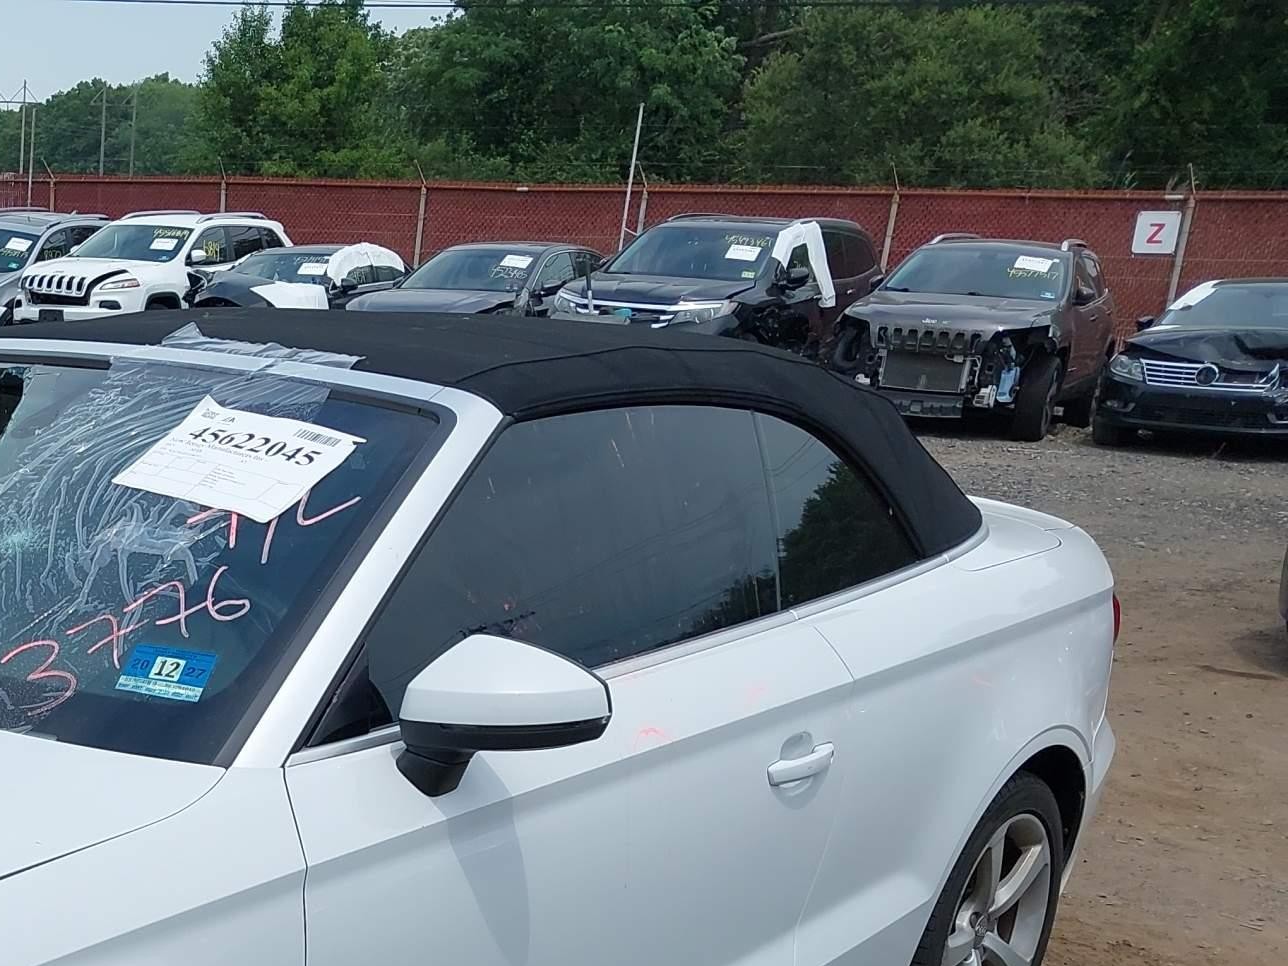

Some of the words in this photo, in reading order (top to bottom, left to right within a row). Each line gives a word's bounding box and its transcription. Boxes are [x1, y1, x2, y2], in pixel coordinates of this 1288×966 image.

[1146, 223, 1167, 244] Z
[189, 426, 322, 467] 45622045
[1, 566, 251, 716] 3776
[131, 658, 150, 671] 20
[153, 659, 181, 679] 12
[184, 666, 207, 679] 27
